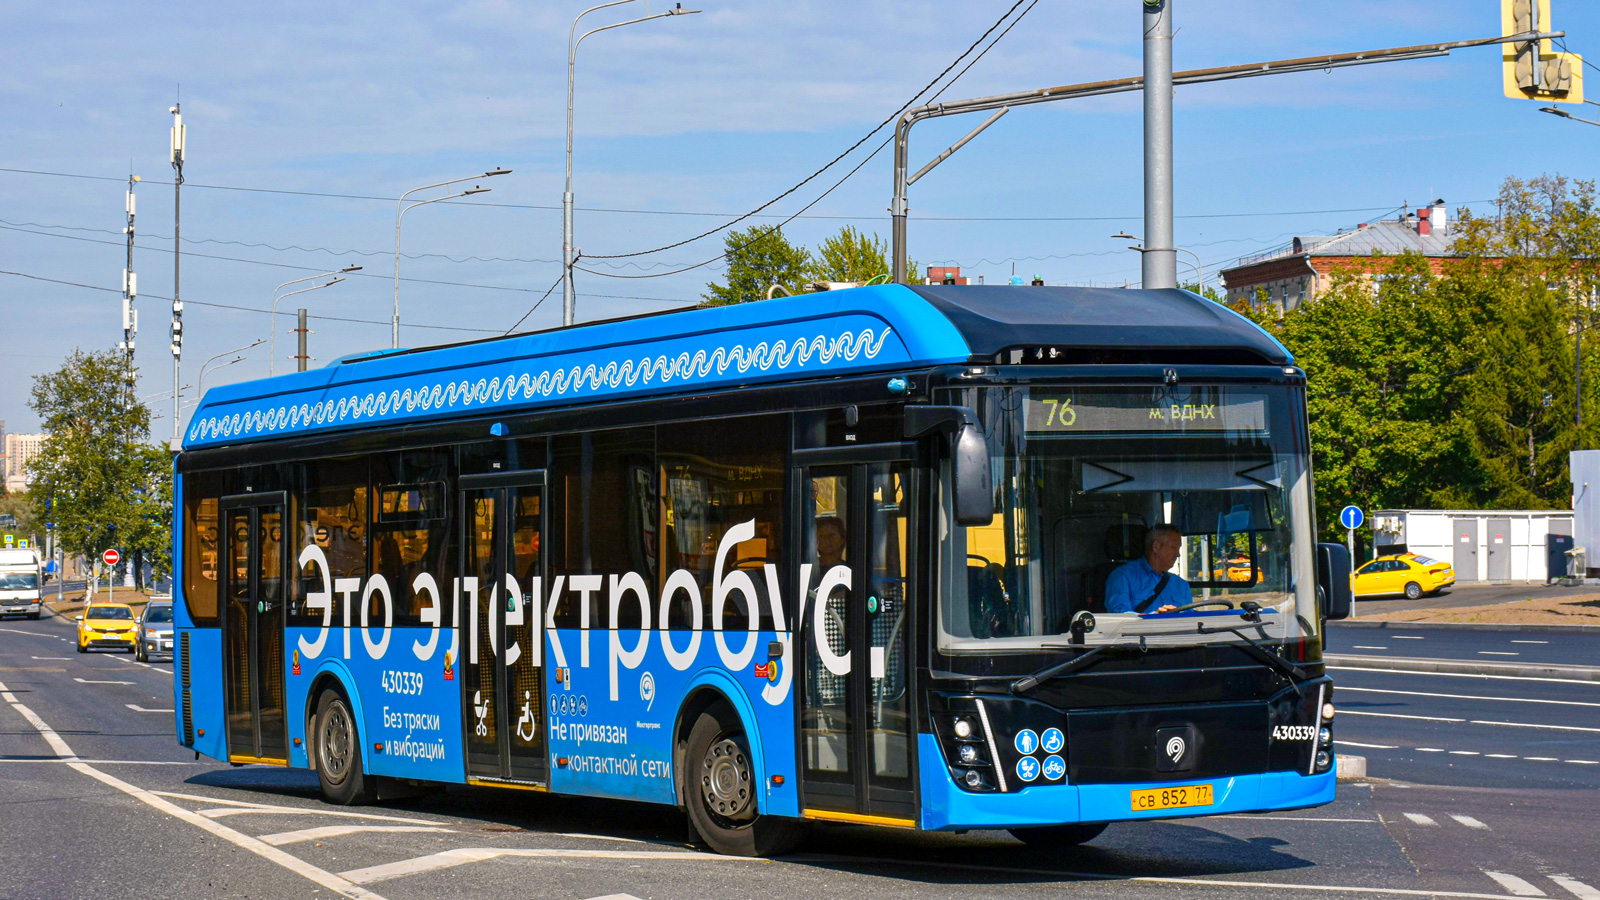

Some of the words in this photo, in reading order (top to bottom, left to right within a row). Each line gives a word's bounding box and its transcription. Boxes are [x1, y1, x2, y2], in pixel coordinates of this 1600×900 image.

[1042, 398, 1076, 426] 76
[1171, 404, 1215, 421] ВДНХ
[297, 544, 393, 660] Это
[381, 670, 424, 696] 430339
[383, 706, 403, 729] Без
[403, 712, 440, 734] тряски
[550, 716, 567, 741] Не
[569, 723, 628, 747] привязан
[1272, 725, 1316, 740] 430339
[385, 740, 392, 756] и
[393, 734, 446, 763] вибраций
[567, 753, 638, 776] контактной
[641, 759, 671, 779] сети
[1161, 789, 1187, 806] 852
[1195, 786, 1208, 799] 77
